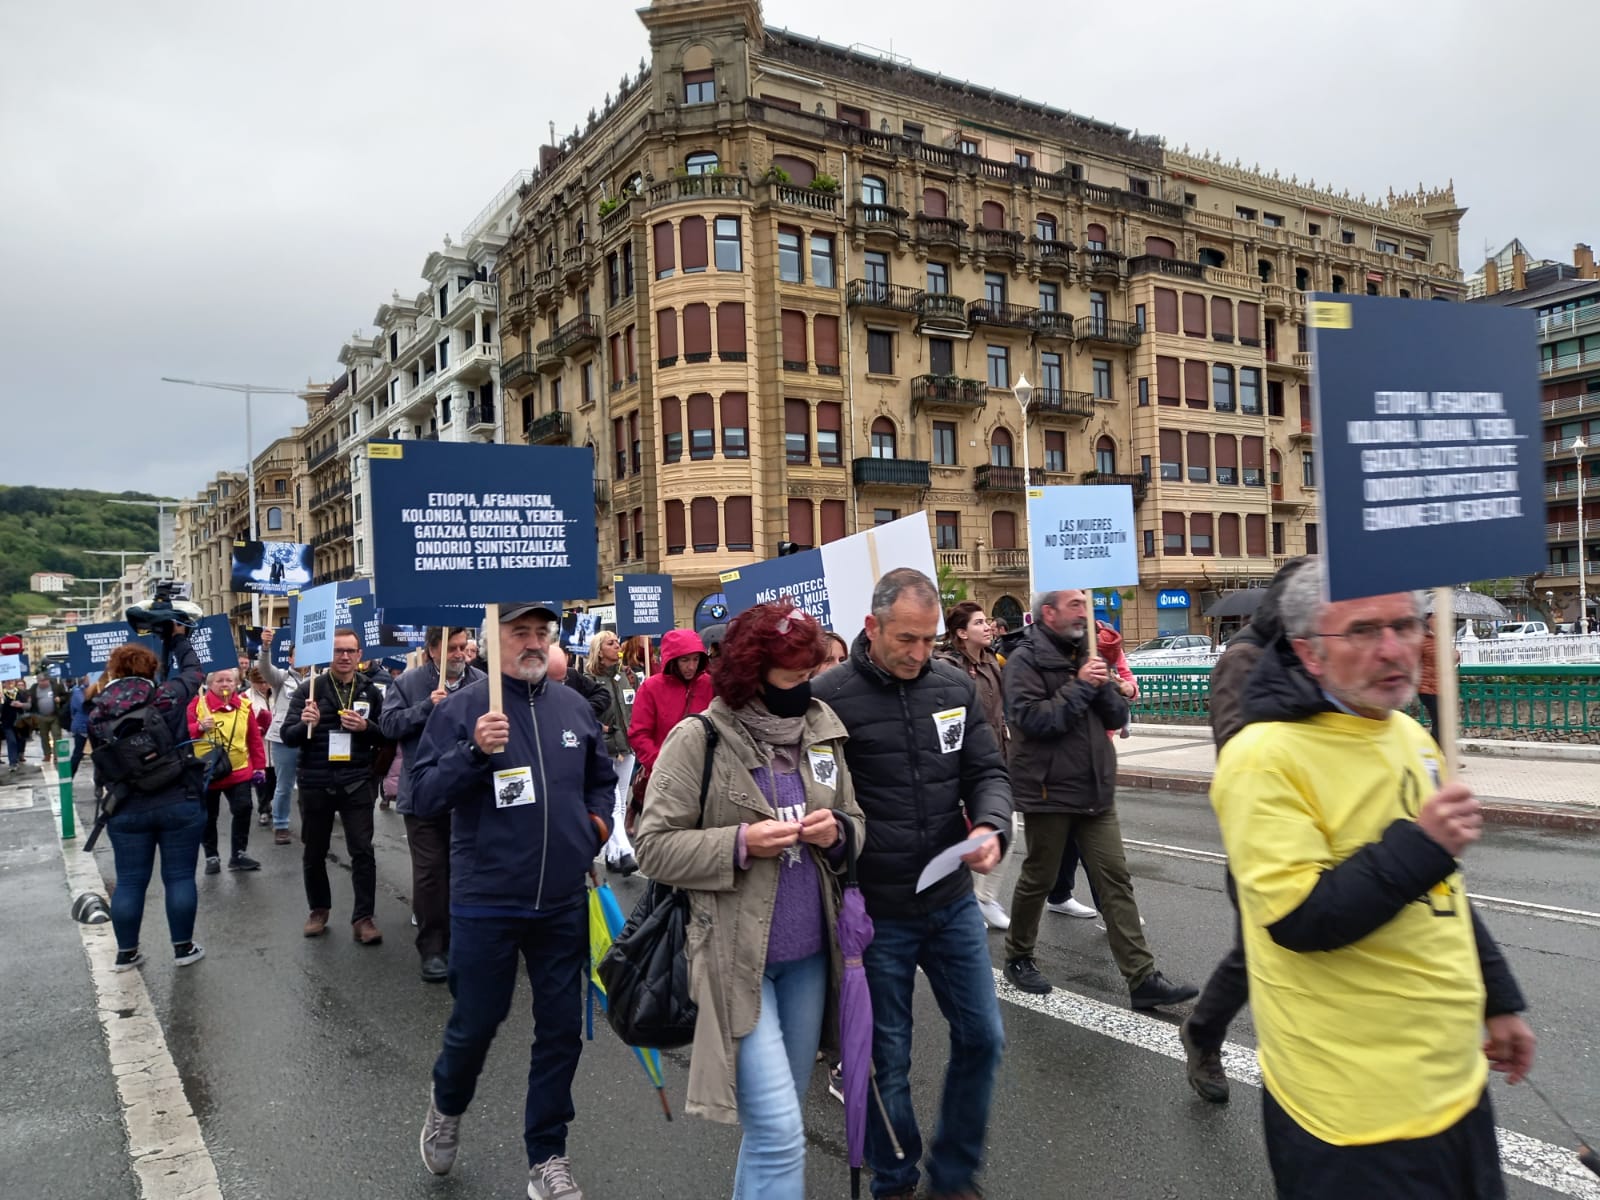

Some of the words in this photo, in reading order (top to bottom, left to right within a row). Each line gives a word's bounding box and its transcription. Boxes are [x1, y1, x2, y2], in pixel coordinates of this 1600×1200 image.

[428, 492, 480, 508] ETIOPIA,
[482, 494, 555, 509] AFGANISTAN,
[401, 508, 467, 524] KOLONBIA,
[469, 509, 523, 524] UKRAINA,
[525, 509, 577, 523] YEMEN...
[414, 525, 467, 539] GATAZKA
[469, 525, 519, 538] GUZTIEK
[520, 525, 566, 538] DITUZTE
[1059, 519, 1074, 532] LAS
[1077, 518, 1112, 532] MUJERES
[1045, 534, 1057, 547] NO
[1059, 533, 1088, 547] SOMOS
[1090, 532, 1102, 545] UN
[1104, 529, 1127, 544] BOTÍN
[415, 540, 471, 555] ONDORIO
[474, 539, 566, 554] SUNTSITZAILEAK
[1064, 547, 1075, 560] DE
[1077, 546, 1112, 560] GUERRA.
[414, 556, 475, 571] EMAKUME
[477, 556, 498, 570] ETA
[500, 555, 571, 569] NESKENTZAT.
[756, 588, 777, 605] MÁS
[1168, 597, 1186, 606] IMQ
